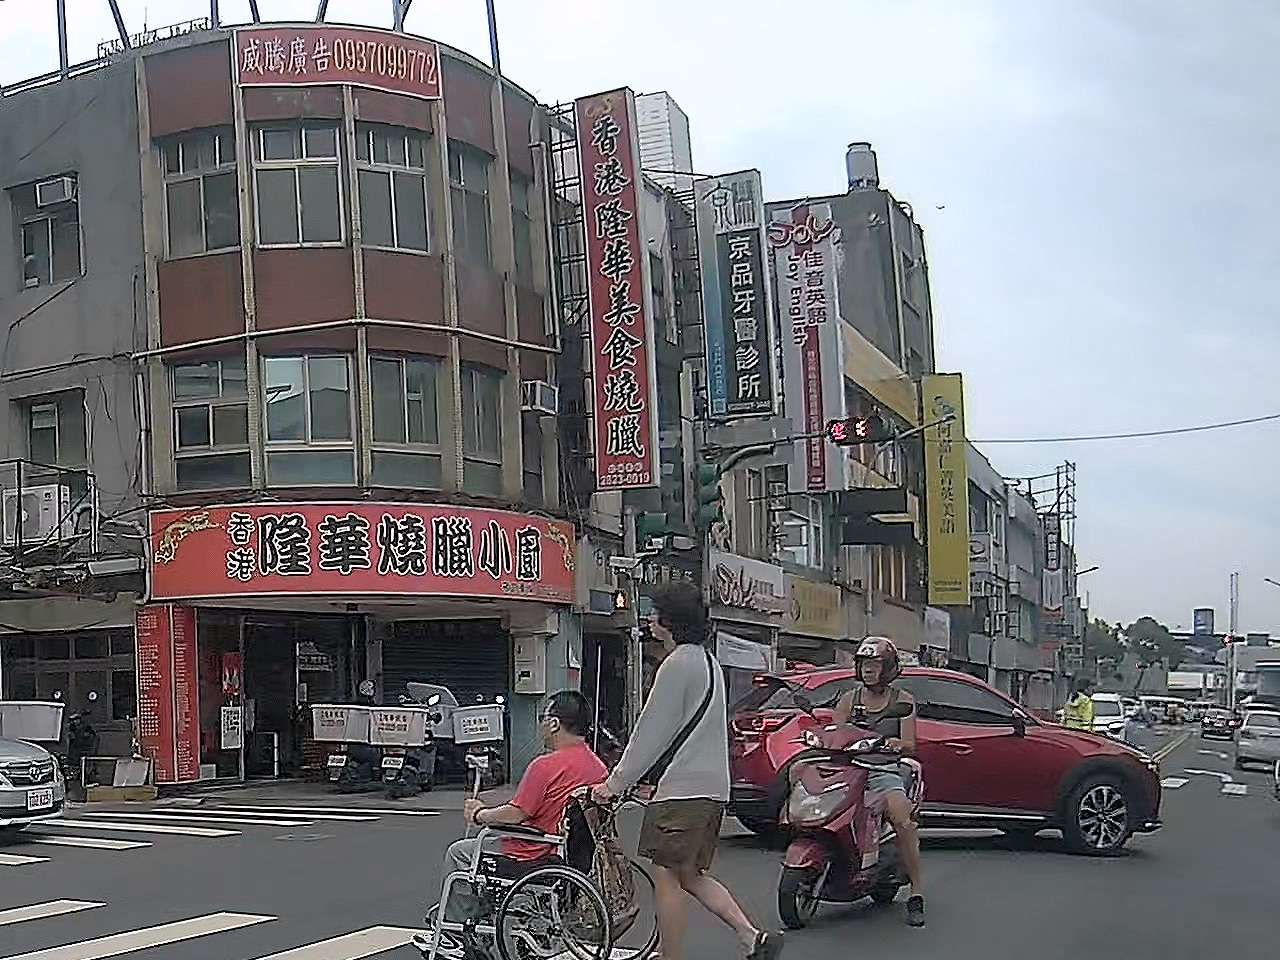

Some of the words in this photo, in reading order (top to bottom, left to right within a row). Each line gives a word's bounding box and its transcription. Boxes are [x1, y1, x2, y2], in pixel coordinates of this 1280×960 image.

[591, 113, 646, 459] 香港隆華美食燒臘
[728, 235, 762, 400] 京品牙醫診所
[789, 286, 809, 345] English
